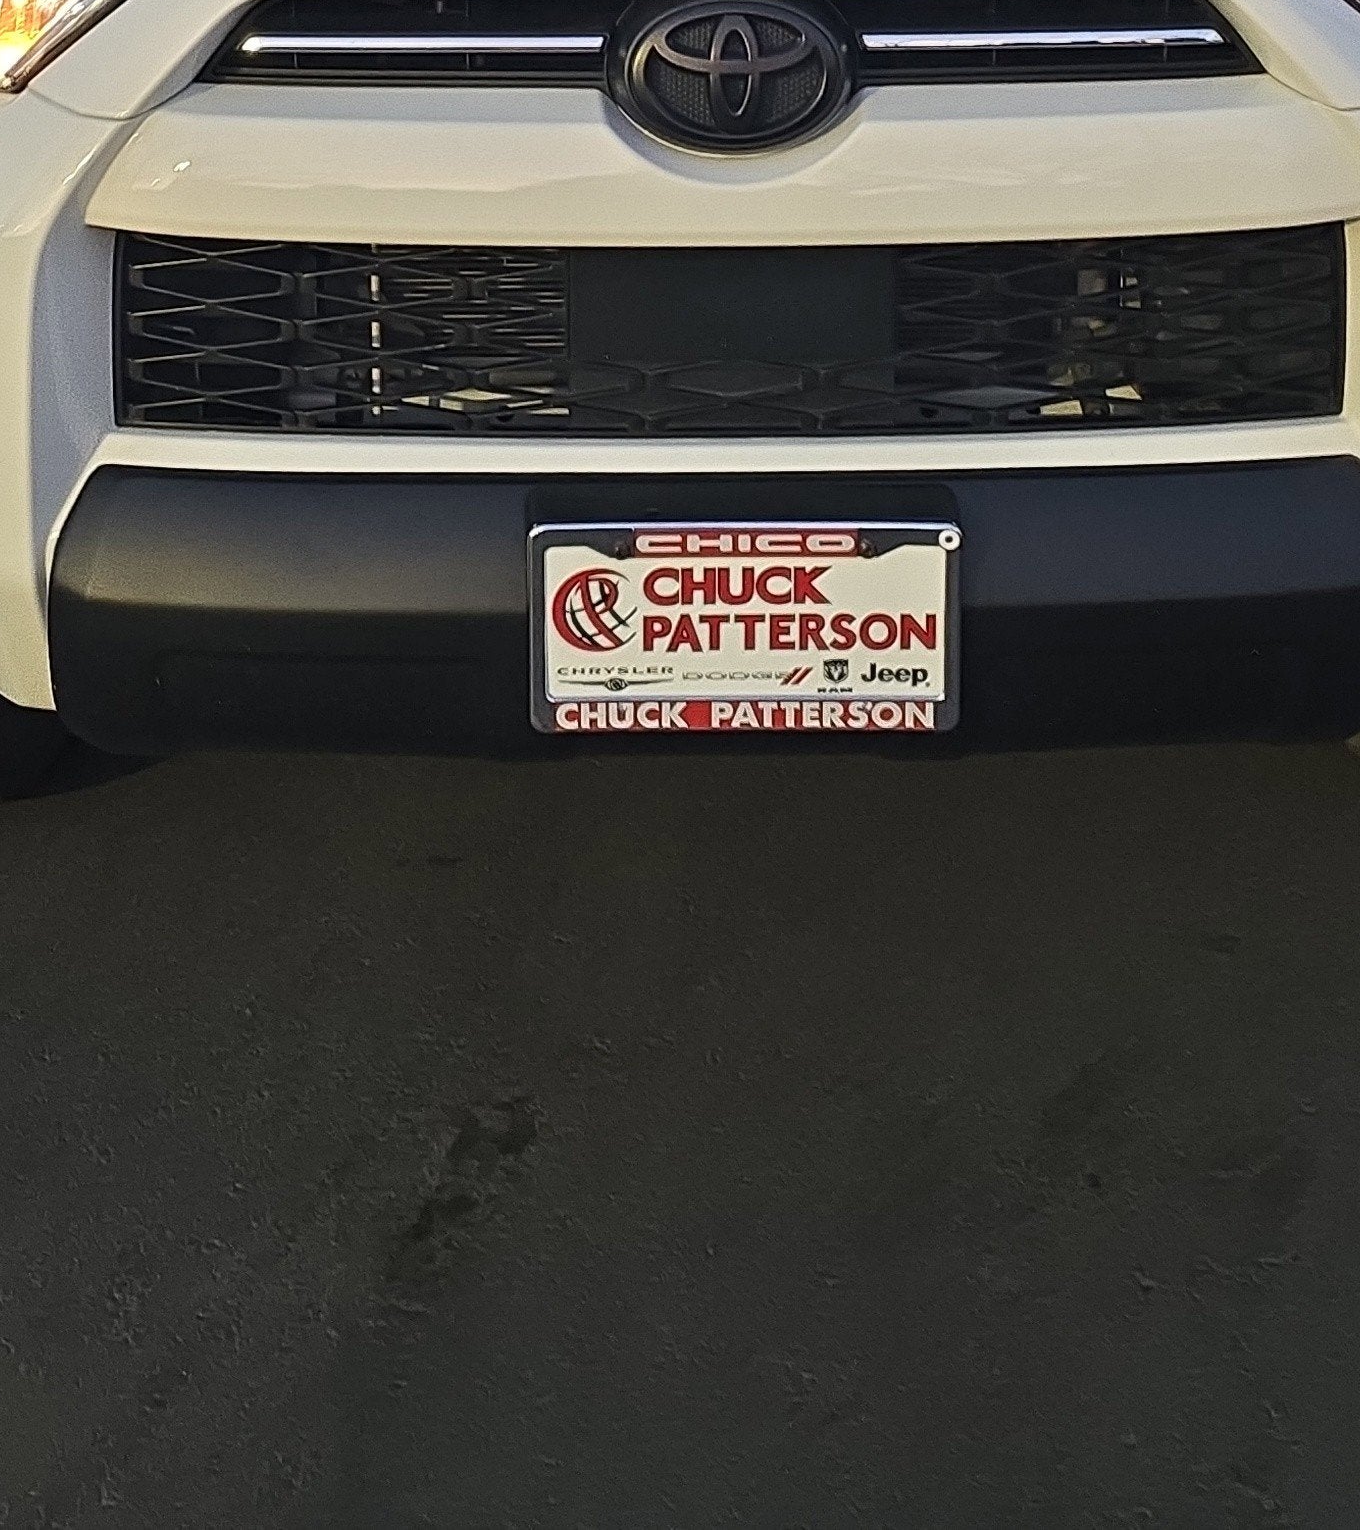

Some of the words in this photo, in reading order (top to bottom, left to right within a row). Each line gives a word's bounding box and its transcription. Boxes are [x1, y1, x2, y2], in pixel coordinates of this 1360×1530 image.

[635, 533, 856, 554] CHICO
[643, 566, 832, 606] CHUCK
[643, 613, 937, 652] PATTERSON
[557, 666, 674, 676] CHRYSLER
[682, 671, 790, 681] DODGE
[860, 662, 929, 687] Jeep
[555, 701, 689, 730] CHUCK
[710, 701, 936, 730] PATTERSON
